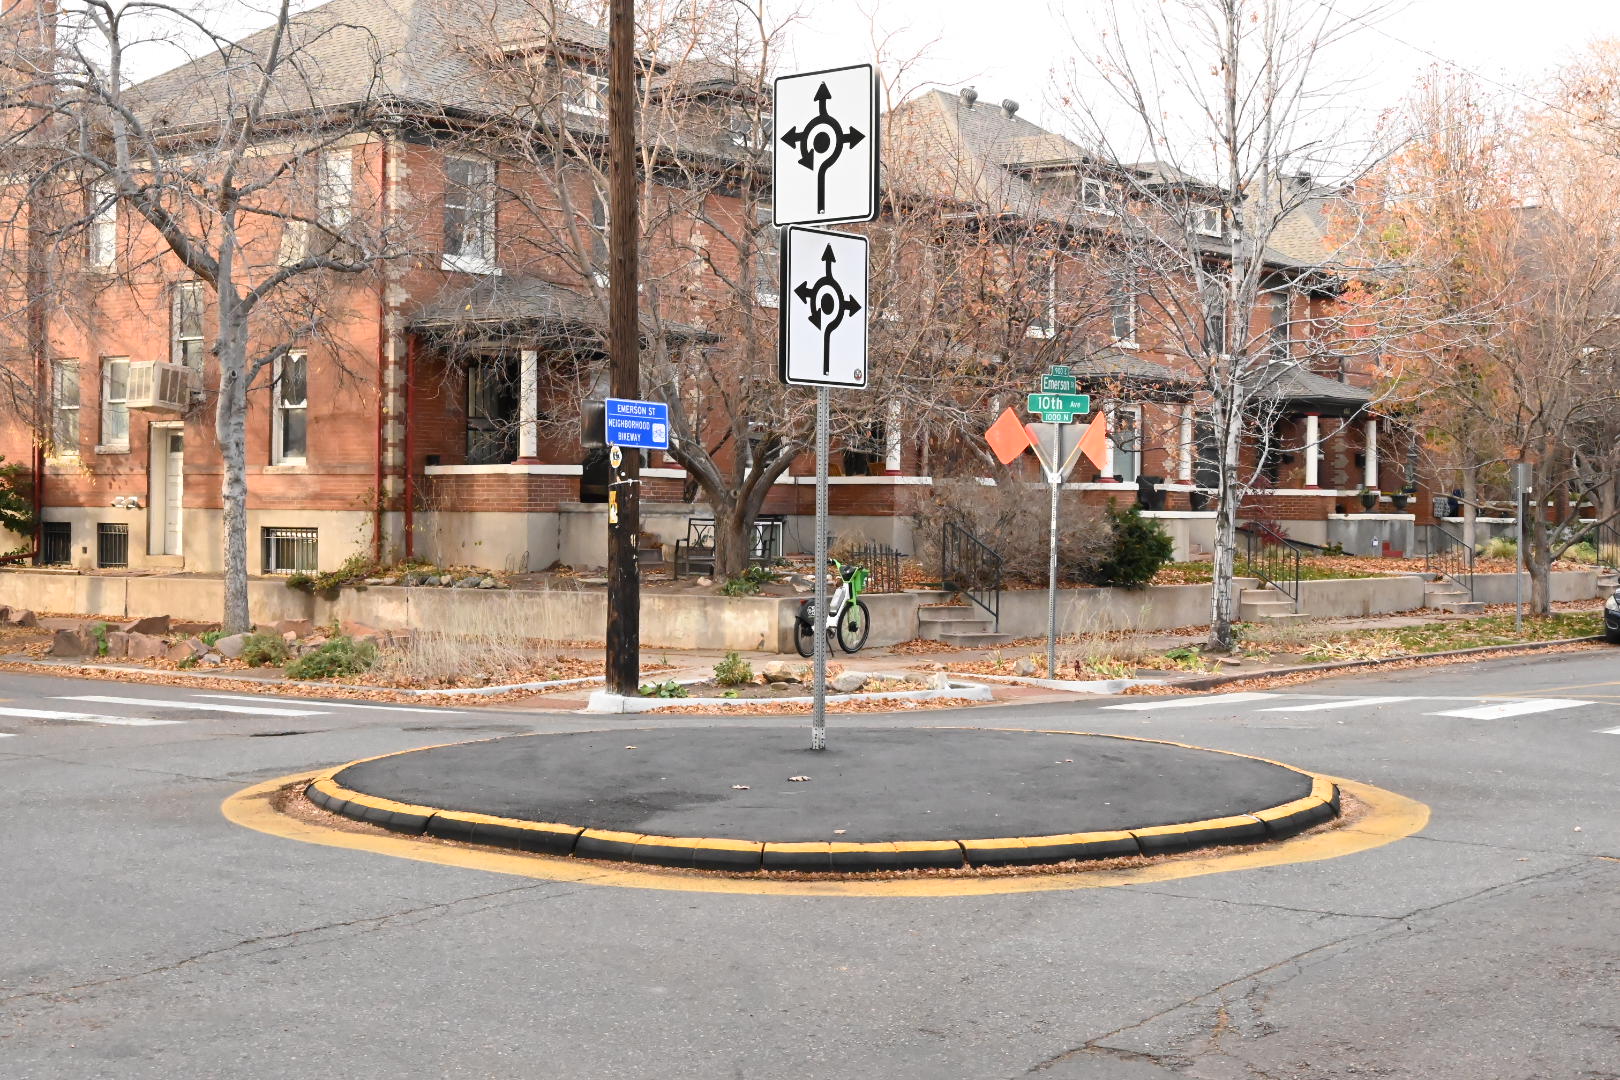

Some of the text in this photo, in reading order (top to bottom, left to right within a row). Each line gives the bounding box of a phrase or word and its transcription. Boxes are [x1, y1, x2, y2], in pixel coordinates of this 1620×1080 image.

[1043, 377, 1070, 390] Emerson
[1038, 396, 1063, 410] 10th
[617, 405, 656, 416] EMERSON ST
[1045, 413, 1061, 421] 1000
[608, 419, 650, 430] NEIGHBORHOOD
[618, 432, 641, 442] BIKEWAY
